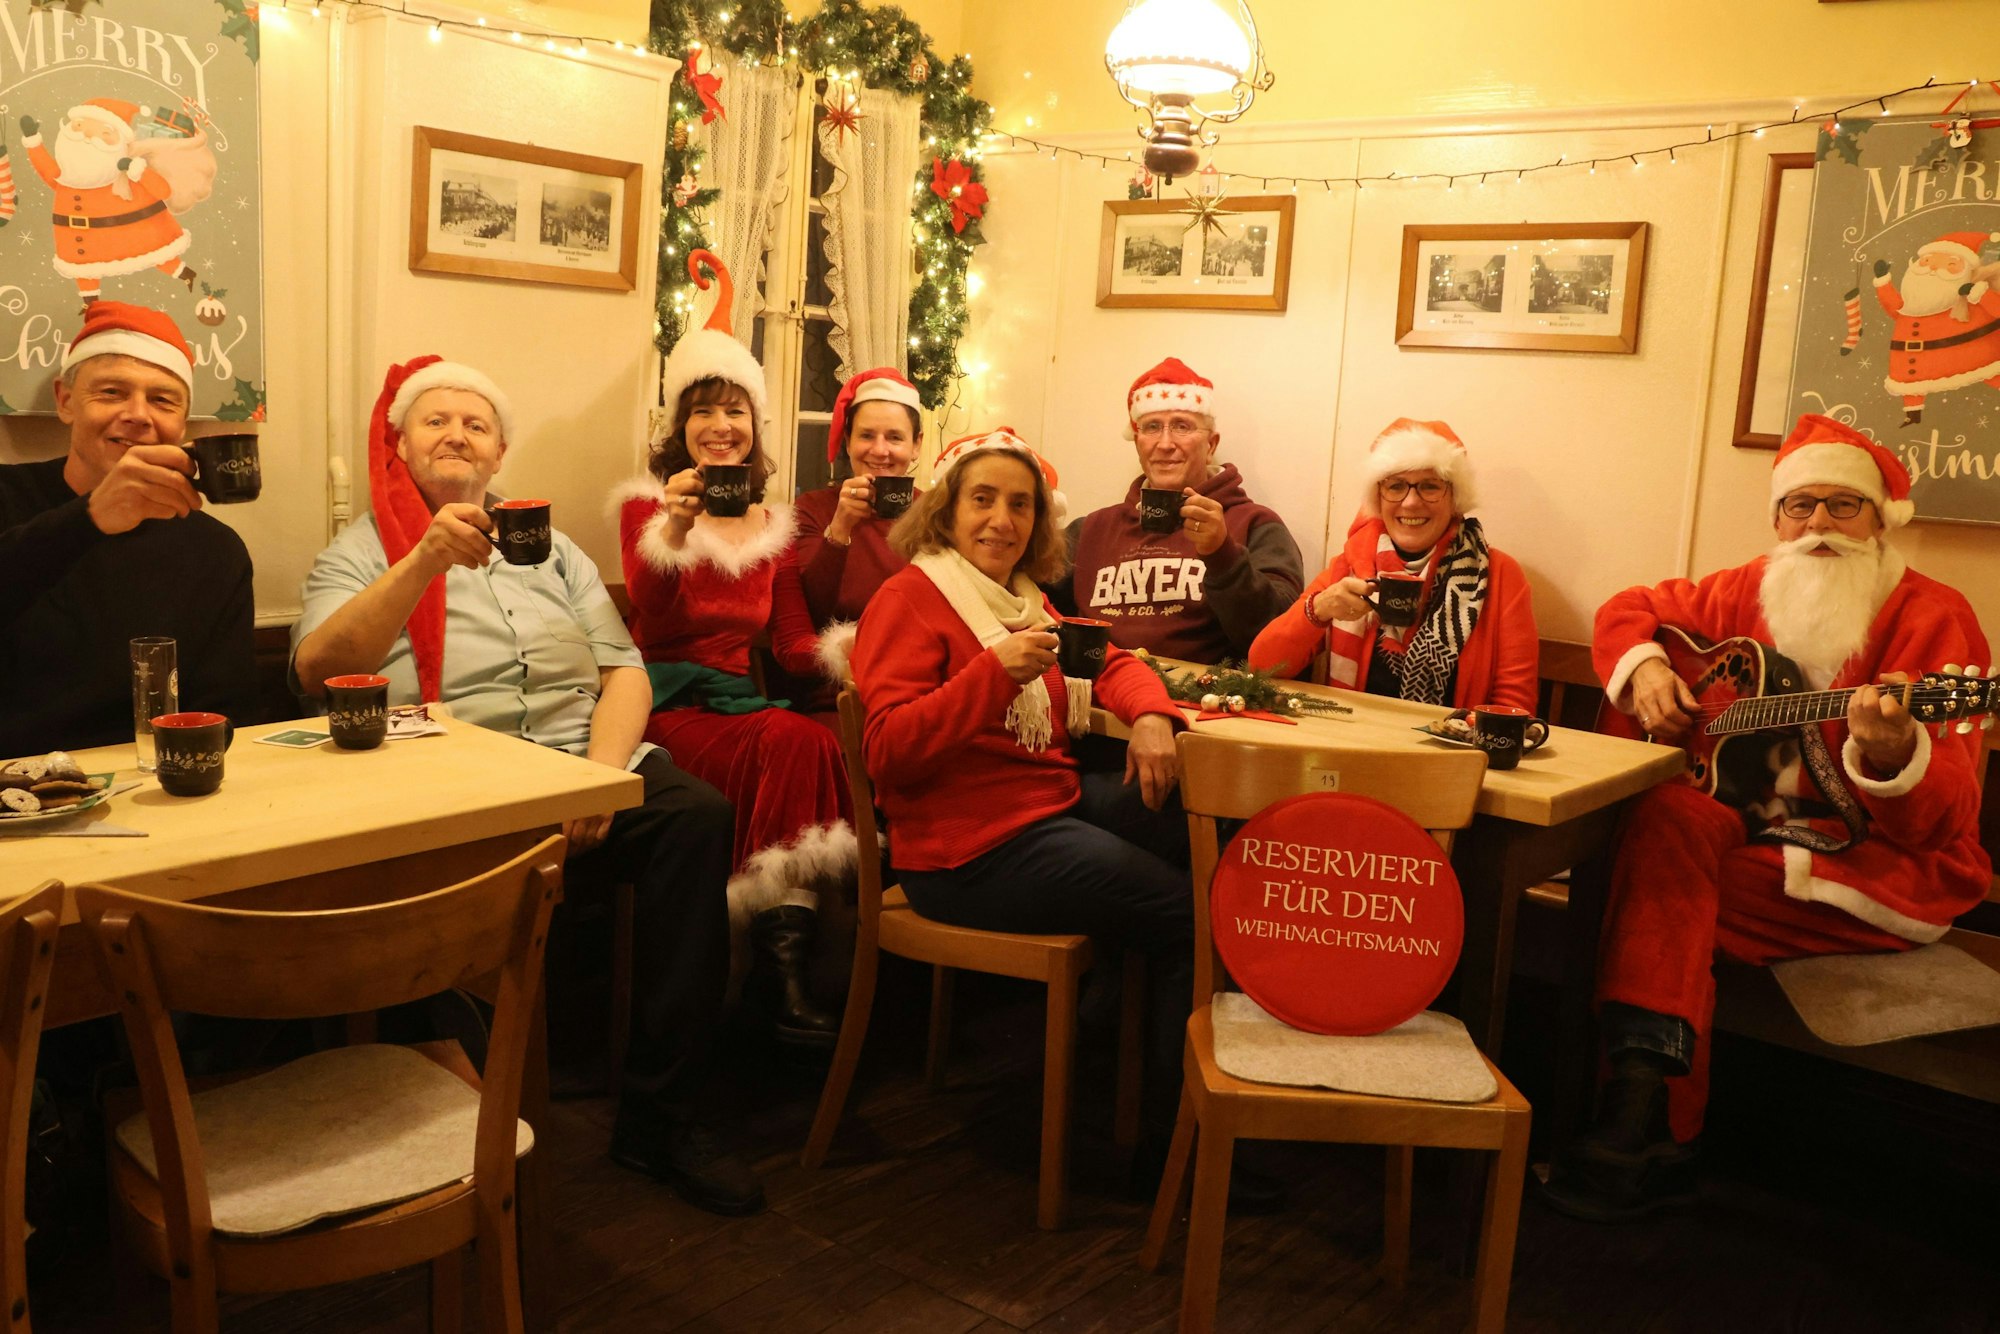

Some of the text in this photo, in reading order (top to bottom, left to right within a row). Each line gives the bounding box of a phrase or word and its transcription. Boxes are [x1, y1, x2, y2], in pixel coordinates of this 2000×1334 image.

[0, 0, 219, 115] MERRY
[1843, 161, 2000, 244] MER
[1089, 557, 1207, 607] BAYER
[1128, 605, 1156, 616] & CO.
[1321, 775, 1335, 788] 19
[1241, 838, 1443, 886] RESERVIERT
[1262, 879, 1415, 924] FÜR DEN
[1234, 917, 1441, 957] WEIHNACHTSMANN
